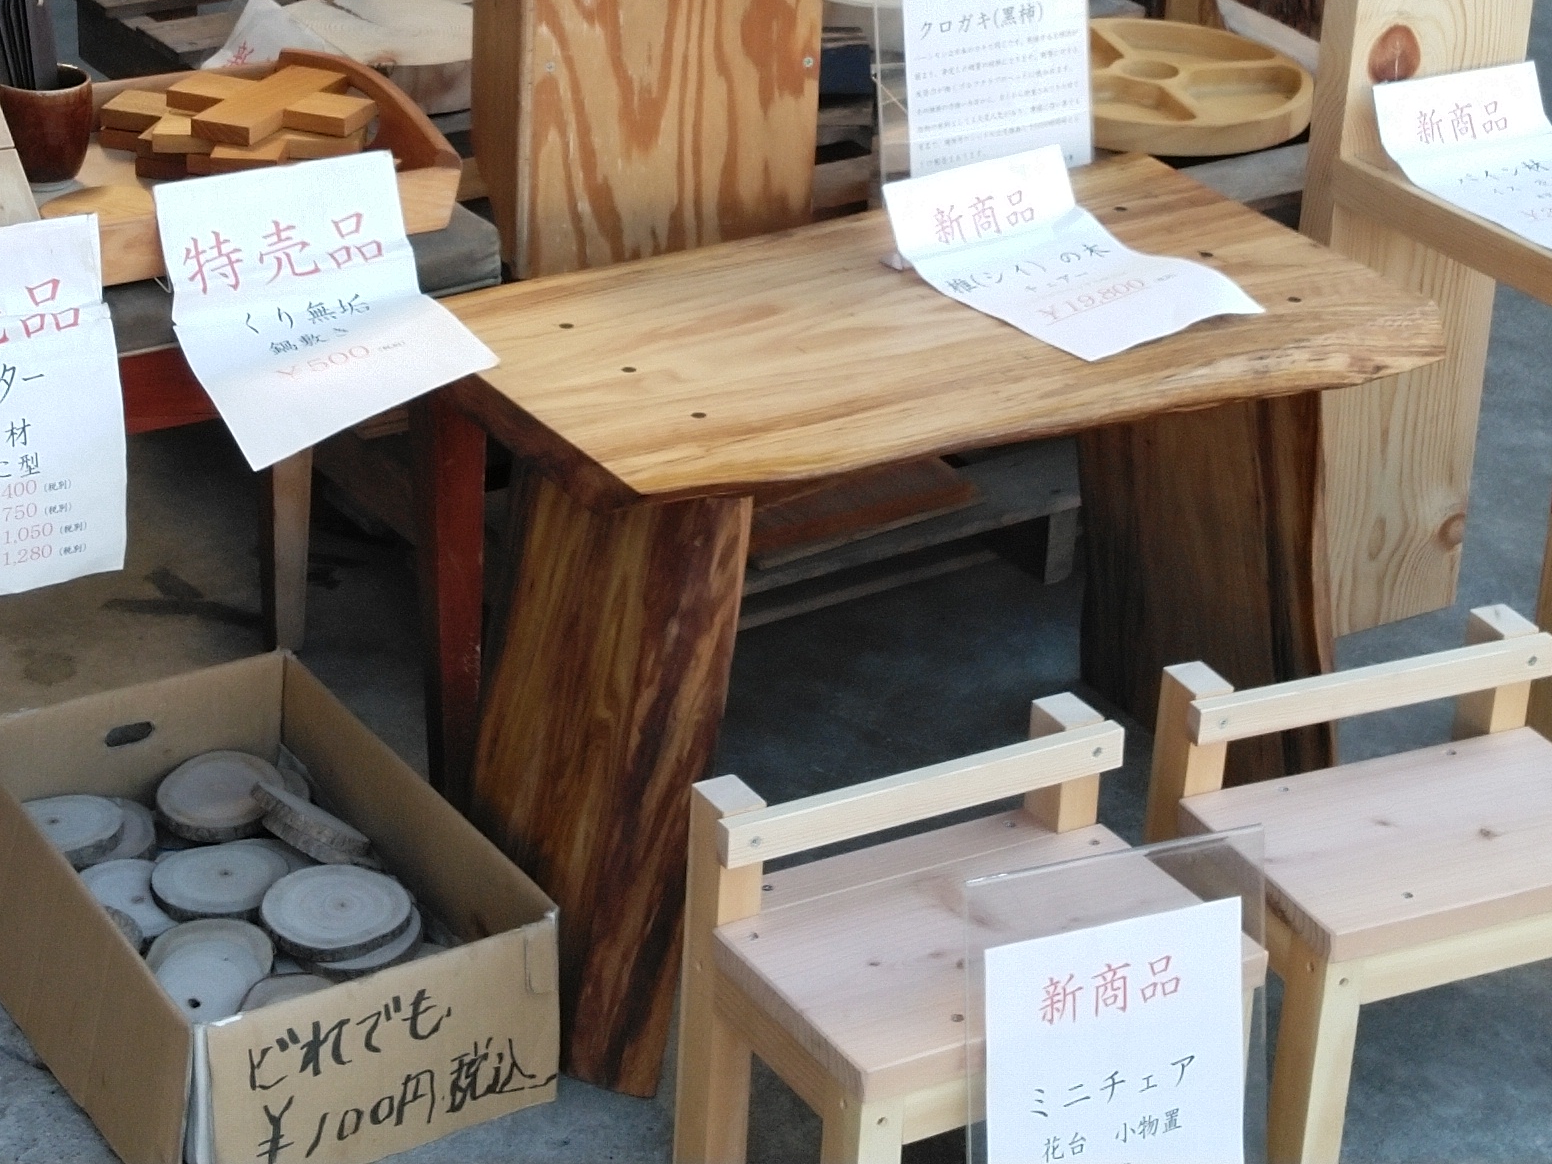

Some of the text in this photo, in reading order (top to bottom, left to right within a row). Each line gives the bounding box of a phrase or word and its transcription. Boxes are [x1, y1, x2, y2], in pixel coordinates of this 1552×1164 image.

[920, 1, 1045, 41] クロガキ(黒柿)
[1415, 99, 1509, 144] 新商品
[932, 189, 1038, 245] 新商品
[183, 211, 385, 295] 特売品
[245, 293, 371, 334] くり無垢
[1038, 954, 1182, 1027] 新商品
[248, 988, 453, 1092] どれでも
[1030, 1055, 1196, 1117] ミニチェア
[1044, 1107, 1183, 1163] 花台 小物置
